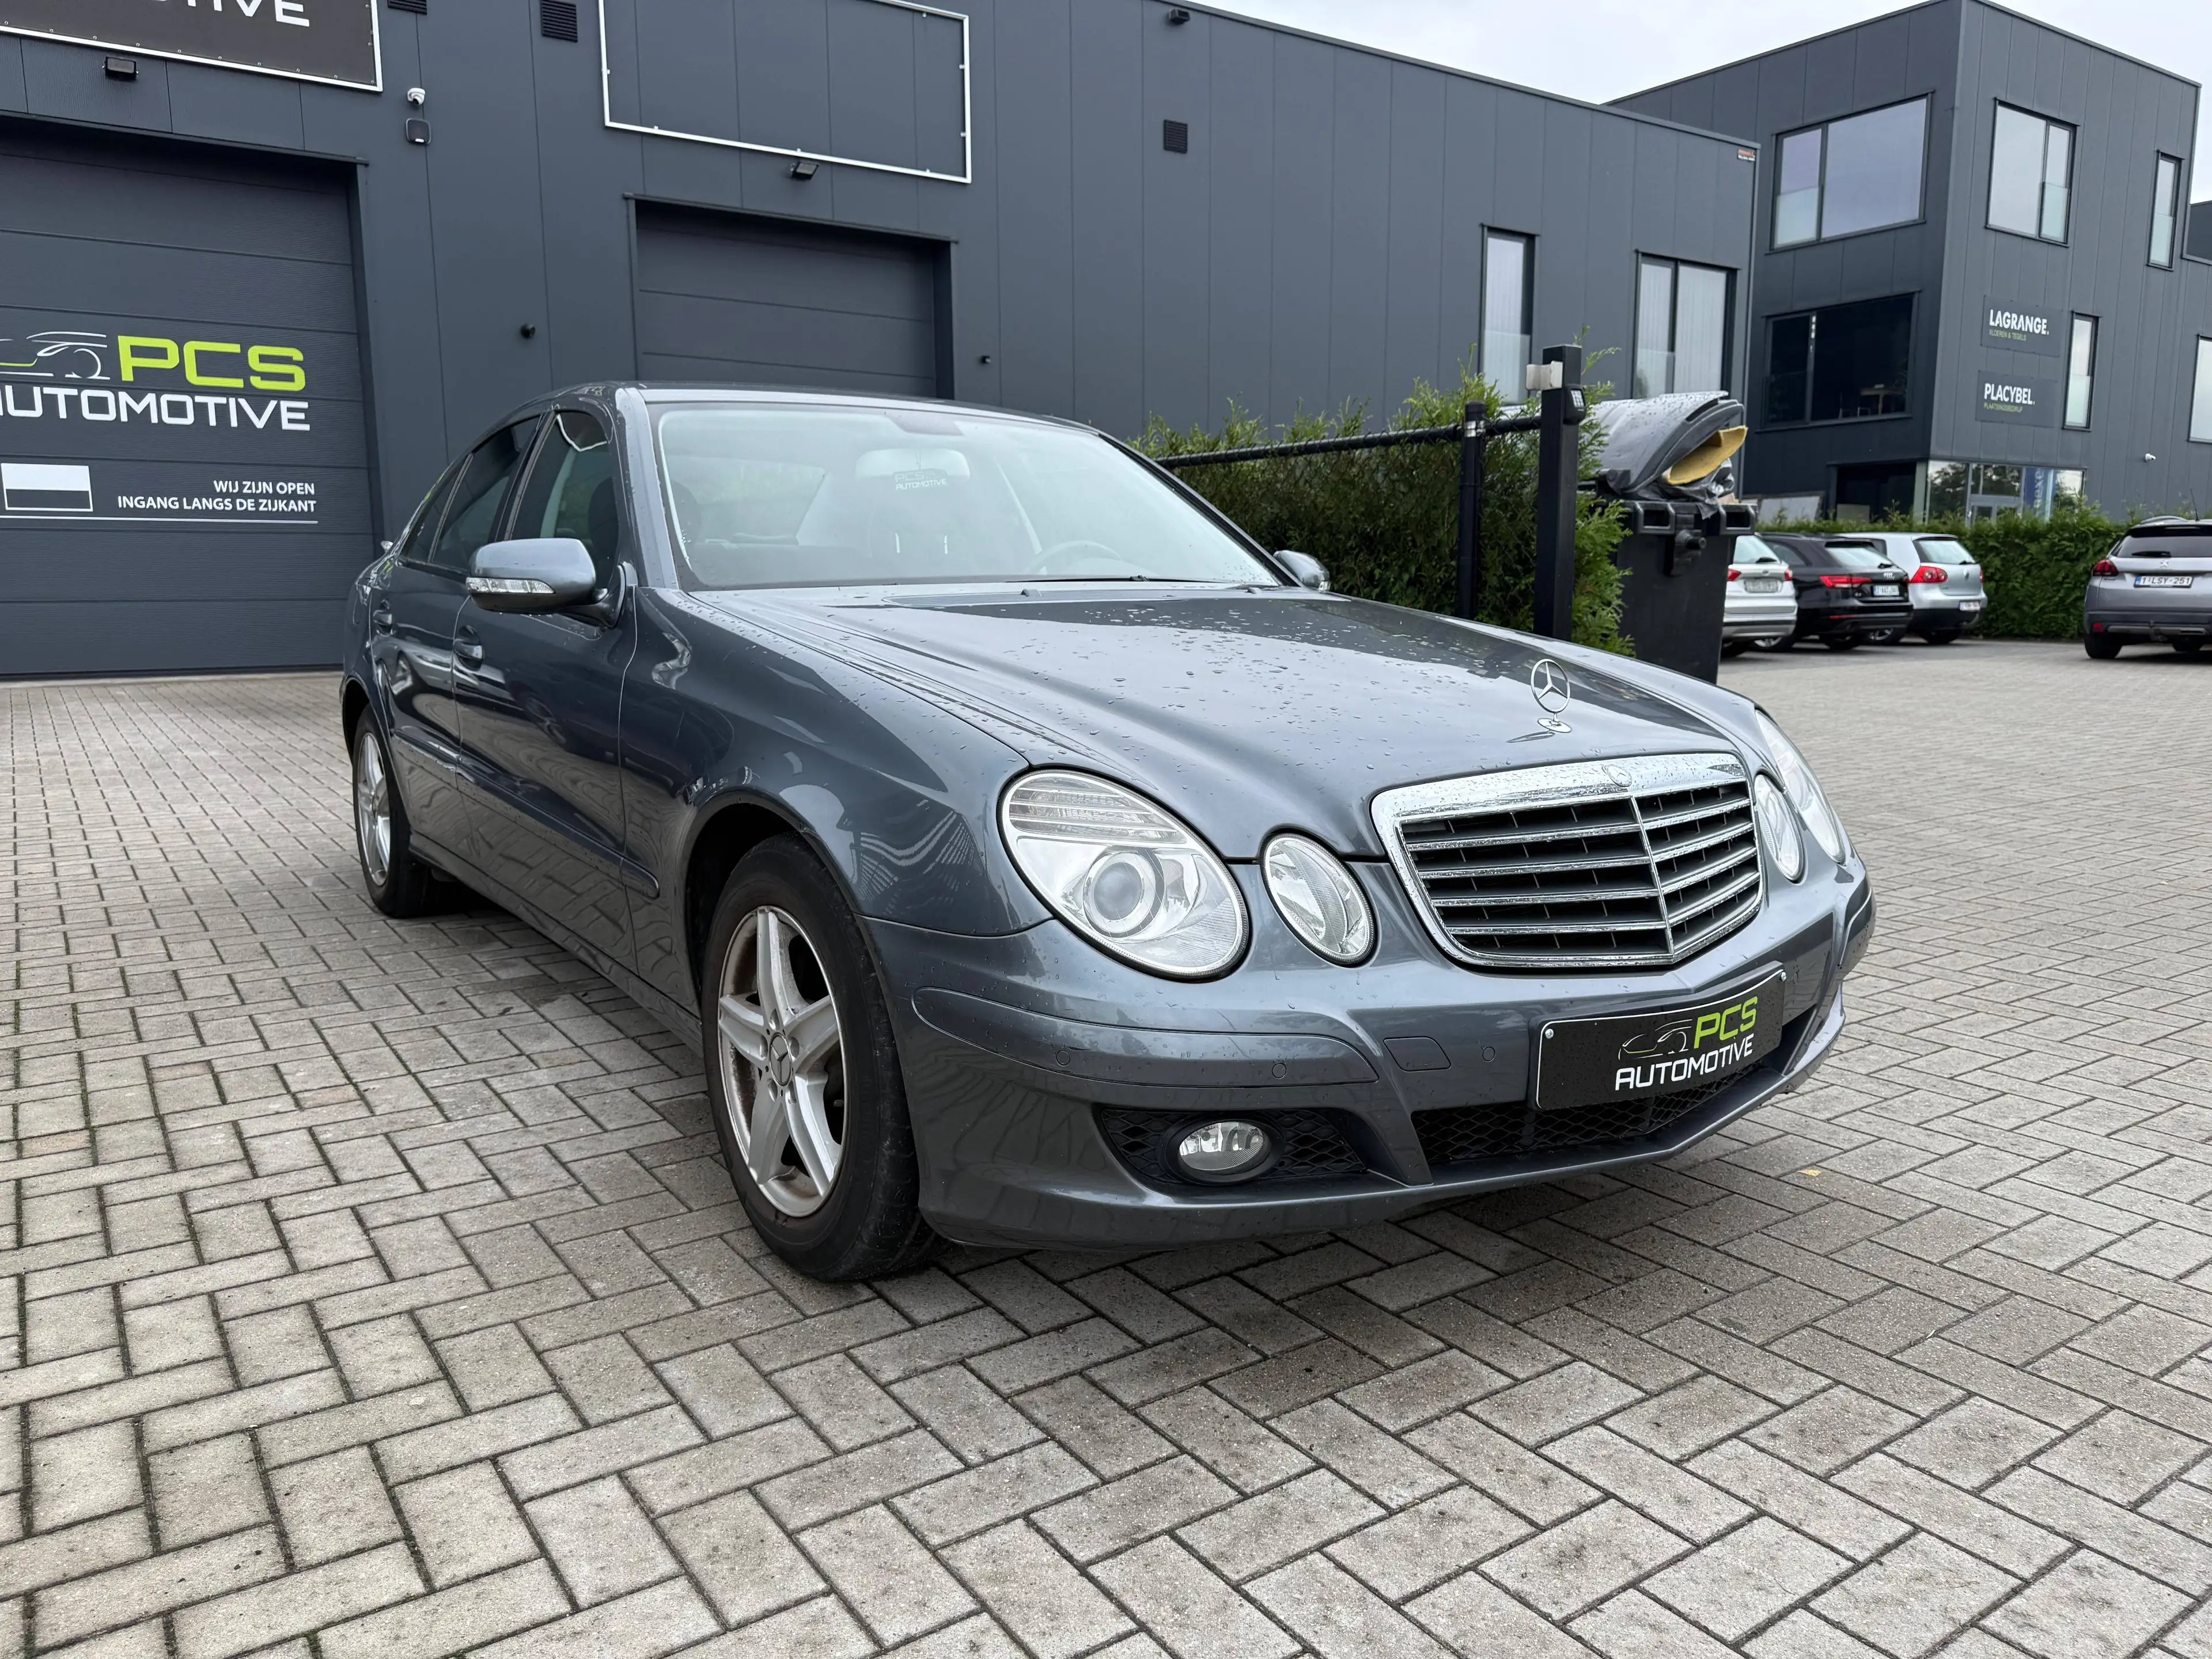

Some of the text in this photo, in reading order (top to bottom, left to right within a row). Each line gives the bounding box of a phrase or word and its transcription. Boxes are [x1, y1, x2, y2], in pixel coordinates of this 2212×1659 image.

[1989, 309, 2050, 335] LAGRANGE.
[118, 335, 306, 391] PCS
[0, 385, 310, 431] UTOMOTIVE
[213, 480, 315, 495] WIJ ZIJN OPEN
[895, 472, 925, 483] PCS
[896, 478, 947, 490] AUTOMOTIVE
[118, 496, 317, 512] INGANG LANGS DE ZIJKANT
[1694, 996, 1758, 1048] PCS
[1615, 1033, 1754, 1090] AUTOMOTIVE
